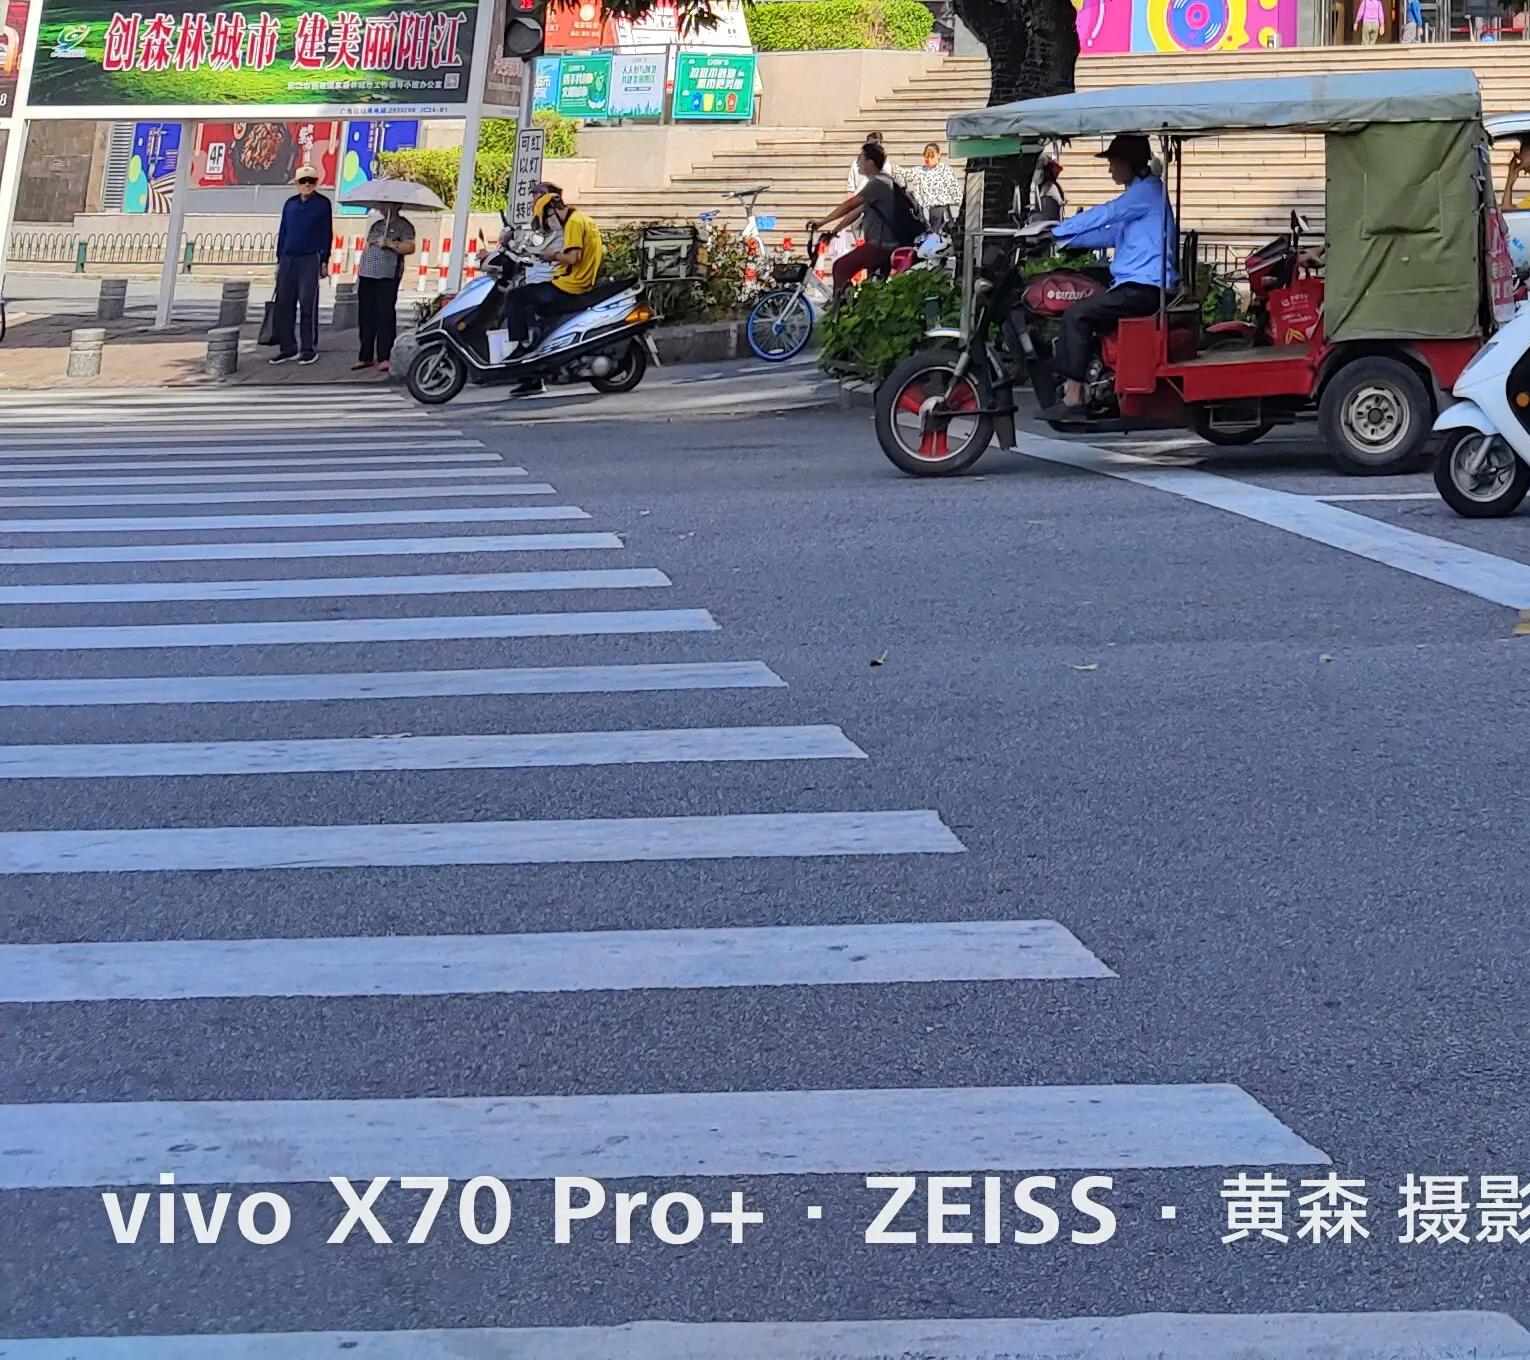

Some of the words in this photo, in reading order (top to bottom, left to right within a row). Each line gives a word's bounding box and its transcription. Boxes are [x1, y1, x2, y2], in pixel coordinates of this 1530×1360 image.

[102, 12, 281, 72] 创森林城市
[290, 10, 468, 70] 建美丽阳江
[210, 145, 223, 165] 4F
[516, 135, 530, 218] 可以右转
